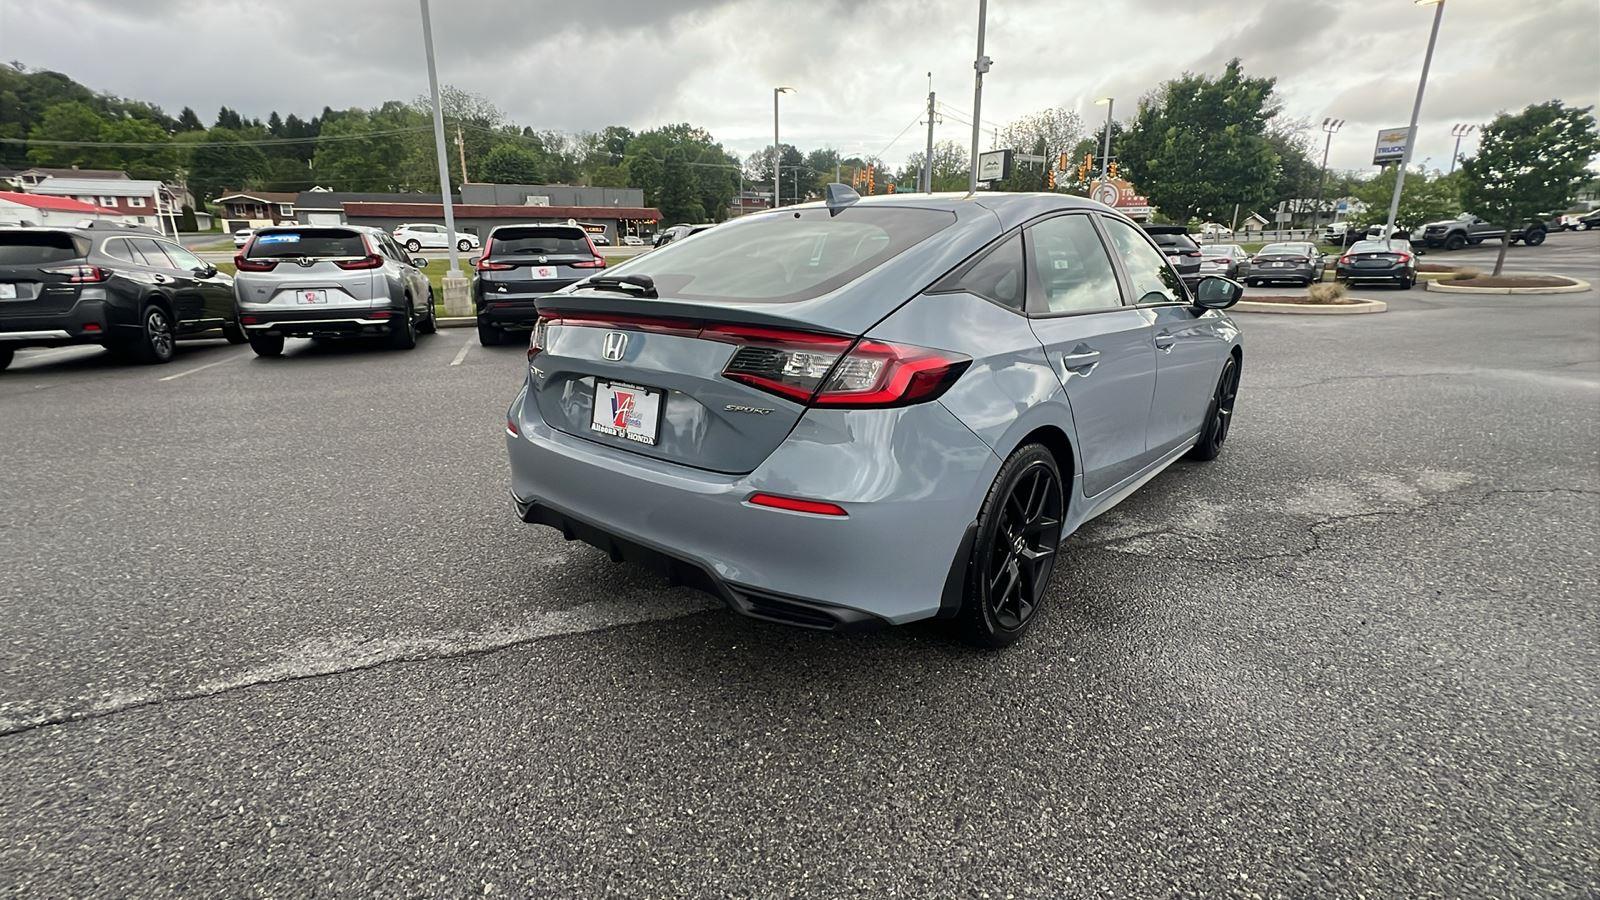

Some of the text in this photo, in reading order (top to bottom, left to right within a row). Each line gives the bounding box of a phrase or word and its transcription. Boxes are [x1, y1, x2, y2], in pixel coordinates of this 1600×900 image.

[724, 404, 775, 415] SPORT
[592, 422, 655, 446] Altoona HONDA
